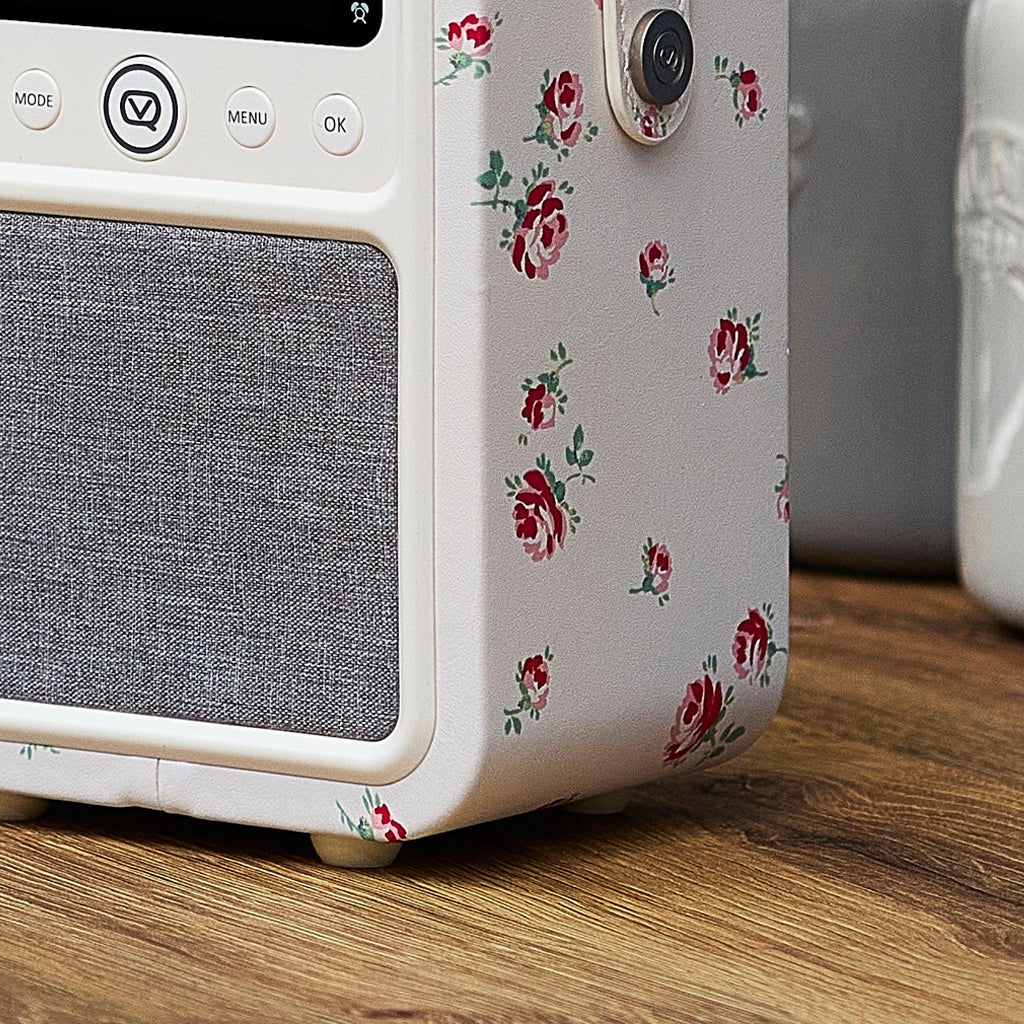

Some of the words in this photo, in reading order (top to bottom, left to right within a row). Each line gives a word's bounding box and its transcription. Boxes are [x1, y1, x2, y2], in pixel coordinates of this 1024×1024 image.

[14, 92, 54, 109] MODE
[228, 110, 268, 127] MENU
[323, 116, 347, 134] OK
